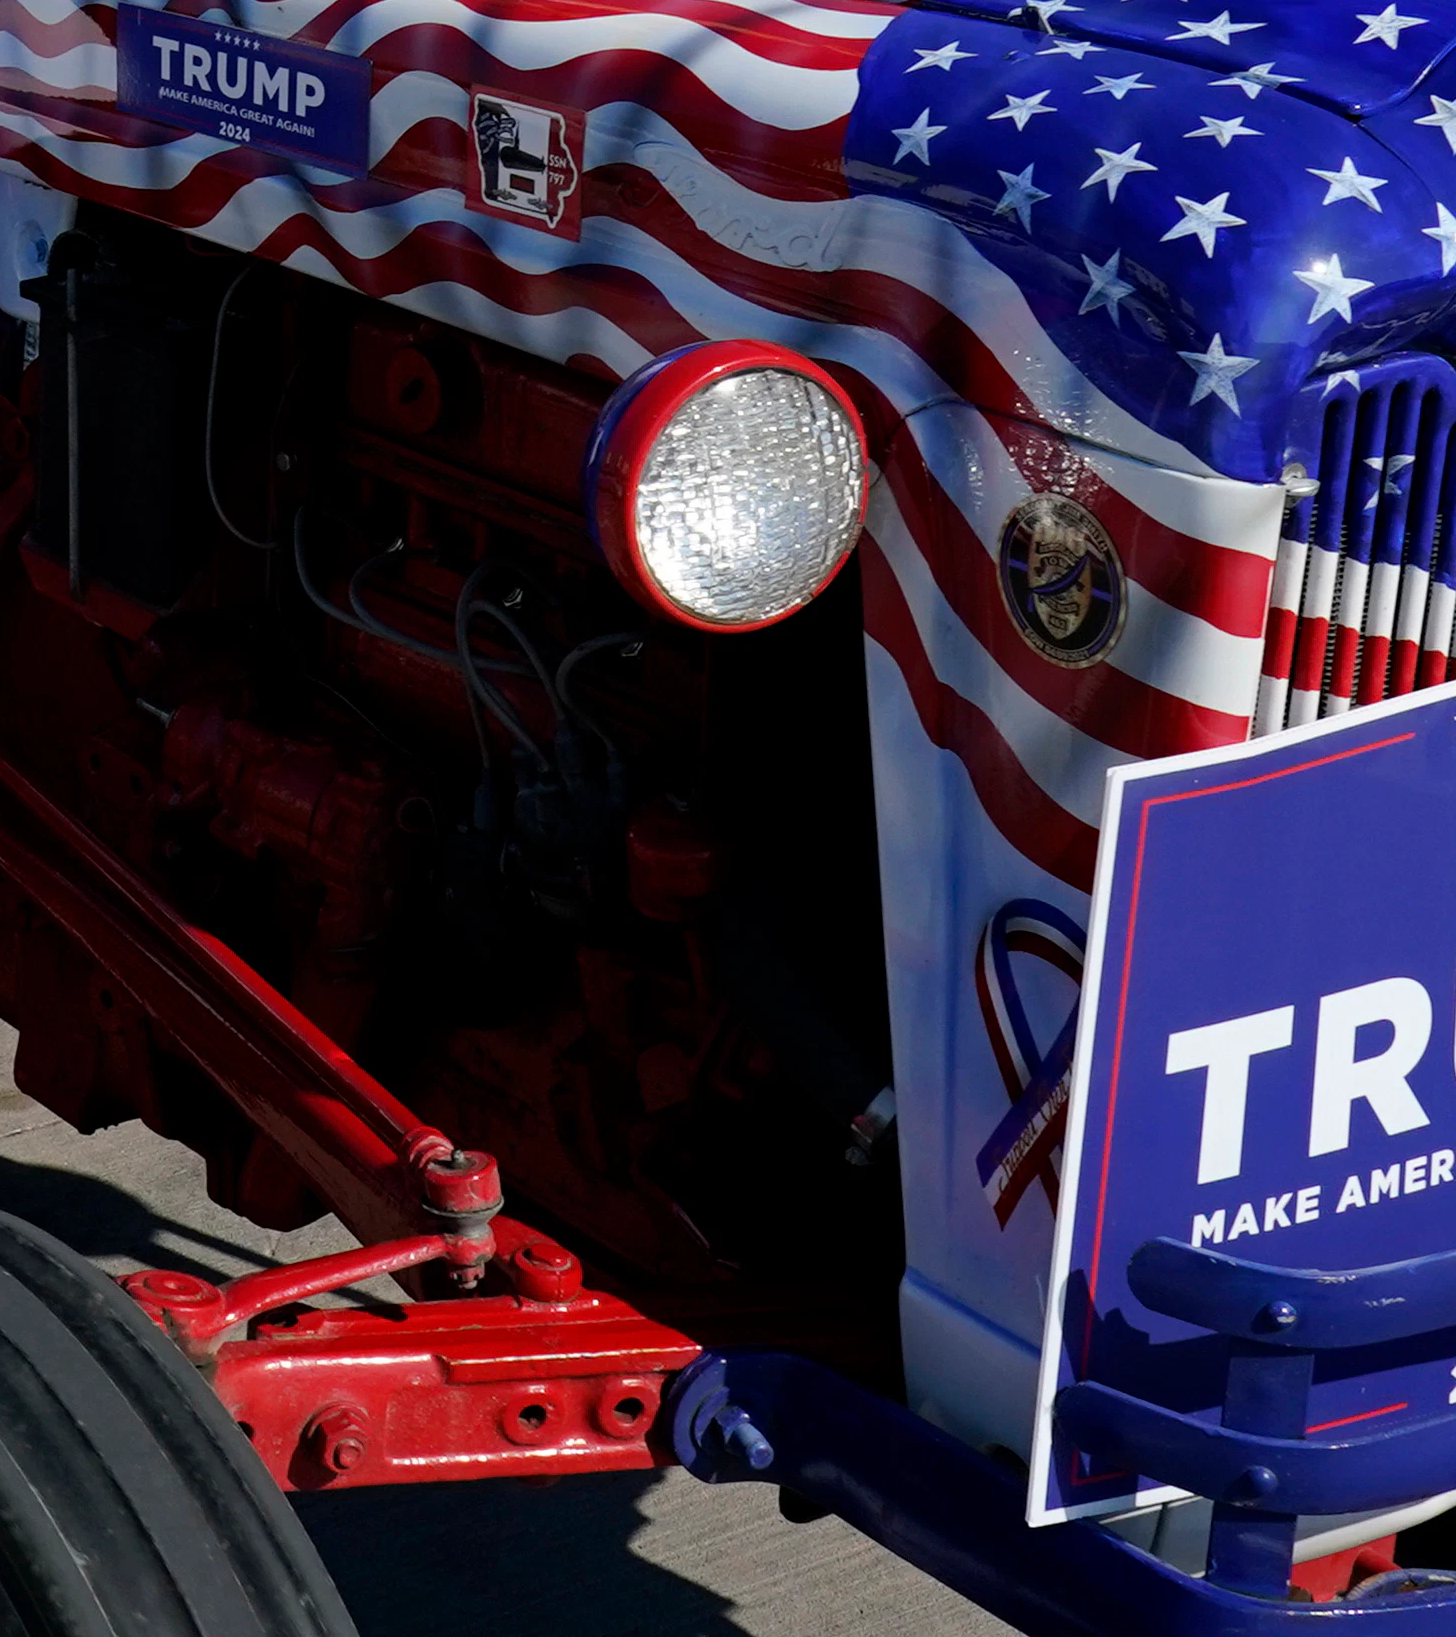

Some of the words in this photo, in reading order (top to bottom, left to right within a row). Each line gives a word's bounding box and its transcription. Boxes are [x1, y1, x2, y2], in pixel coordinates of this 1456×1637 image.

[152, 35, 326, 118] TRUMP
[158, 86, 189, 103] MAKE
[191, 94, 238, 117] AMERICA
[239, 108, 274, 127] GREAT
[276, 118, 315, 138] AGAIN!
[218, 121, 251, 143] 2024
[548, 154, 568, 168] SSN
[548, 171, 565, 186] 797
[1191, 1183, 1321, 1249] MAKE
